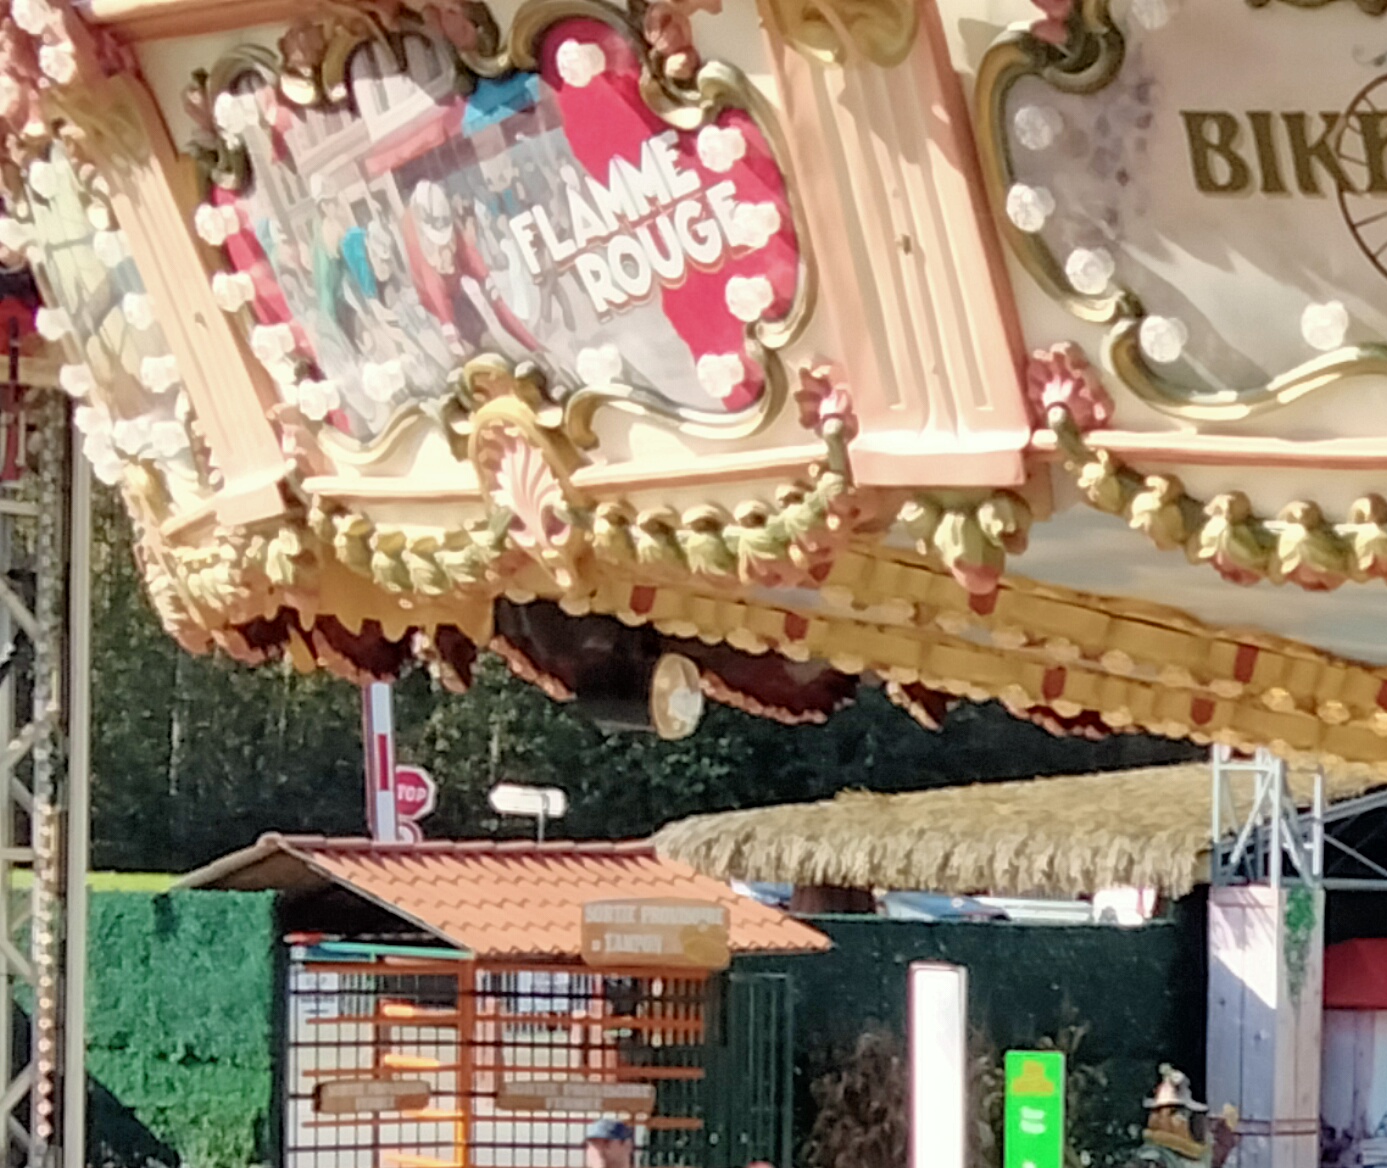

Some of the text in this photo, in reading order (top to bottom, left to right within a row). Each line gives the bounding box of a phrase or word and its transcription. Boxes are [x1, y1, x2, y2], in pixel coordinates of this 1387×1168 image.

[509, 129, 701, 275] FLAMME
[575, 179, 752, 313] ROUGE
[396, 782, 427, 802] TOP
